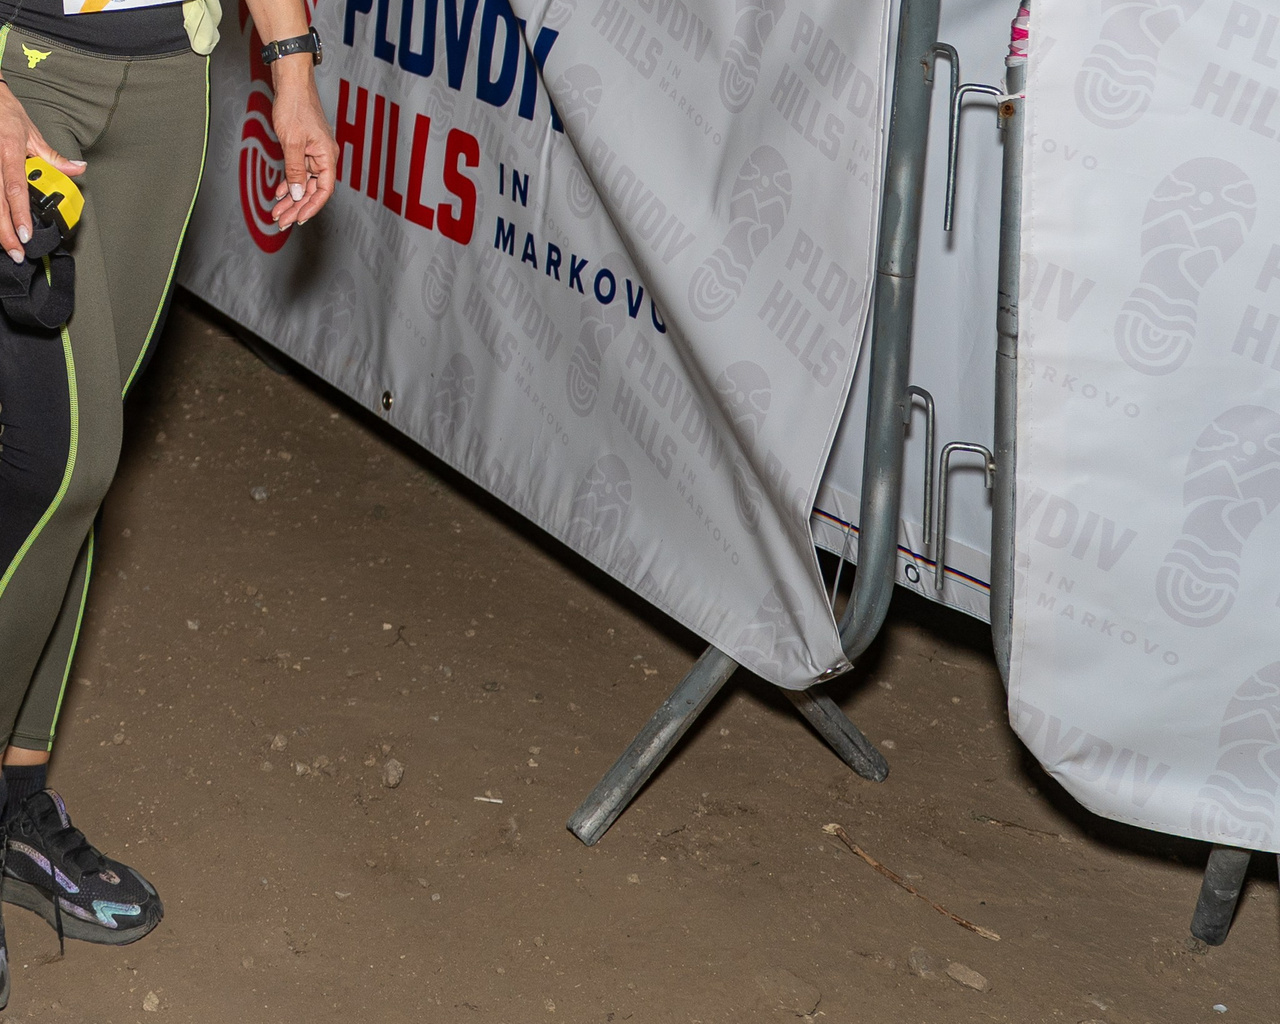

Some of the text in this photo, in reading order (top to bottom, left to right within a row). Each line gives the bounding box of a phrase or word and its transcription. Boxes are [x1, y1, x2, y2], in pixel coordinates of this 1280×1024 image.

[659, 76, 722, 146] MARKOVO
[770, 63, 845, 162] HILLS
[790, 11, 875, 130] PLOVD
[334, 77, 481, 246] HILLS
[498, 162, 530, 208] IN
[463, 282, 519, 373] HILLS
[476, 241, 564, 364] PLOVDIV
[757, 279, 846, 388] HILLS
[611, 376, 678, 480] HILLS
[676, 478, 740, 566] MARKOVO
[1037, 592, 1180, 666] MARKOVO
[1045, 571, 1075, 593] IN
